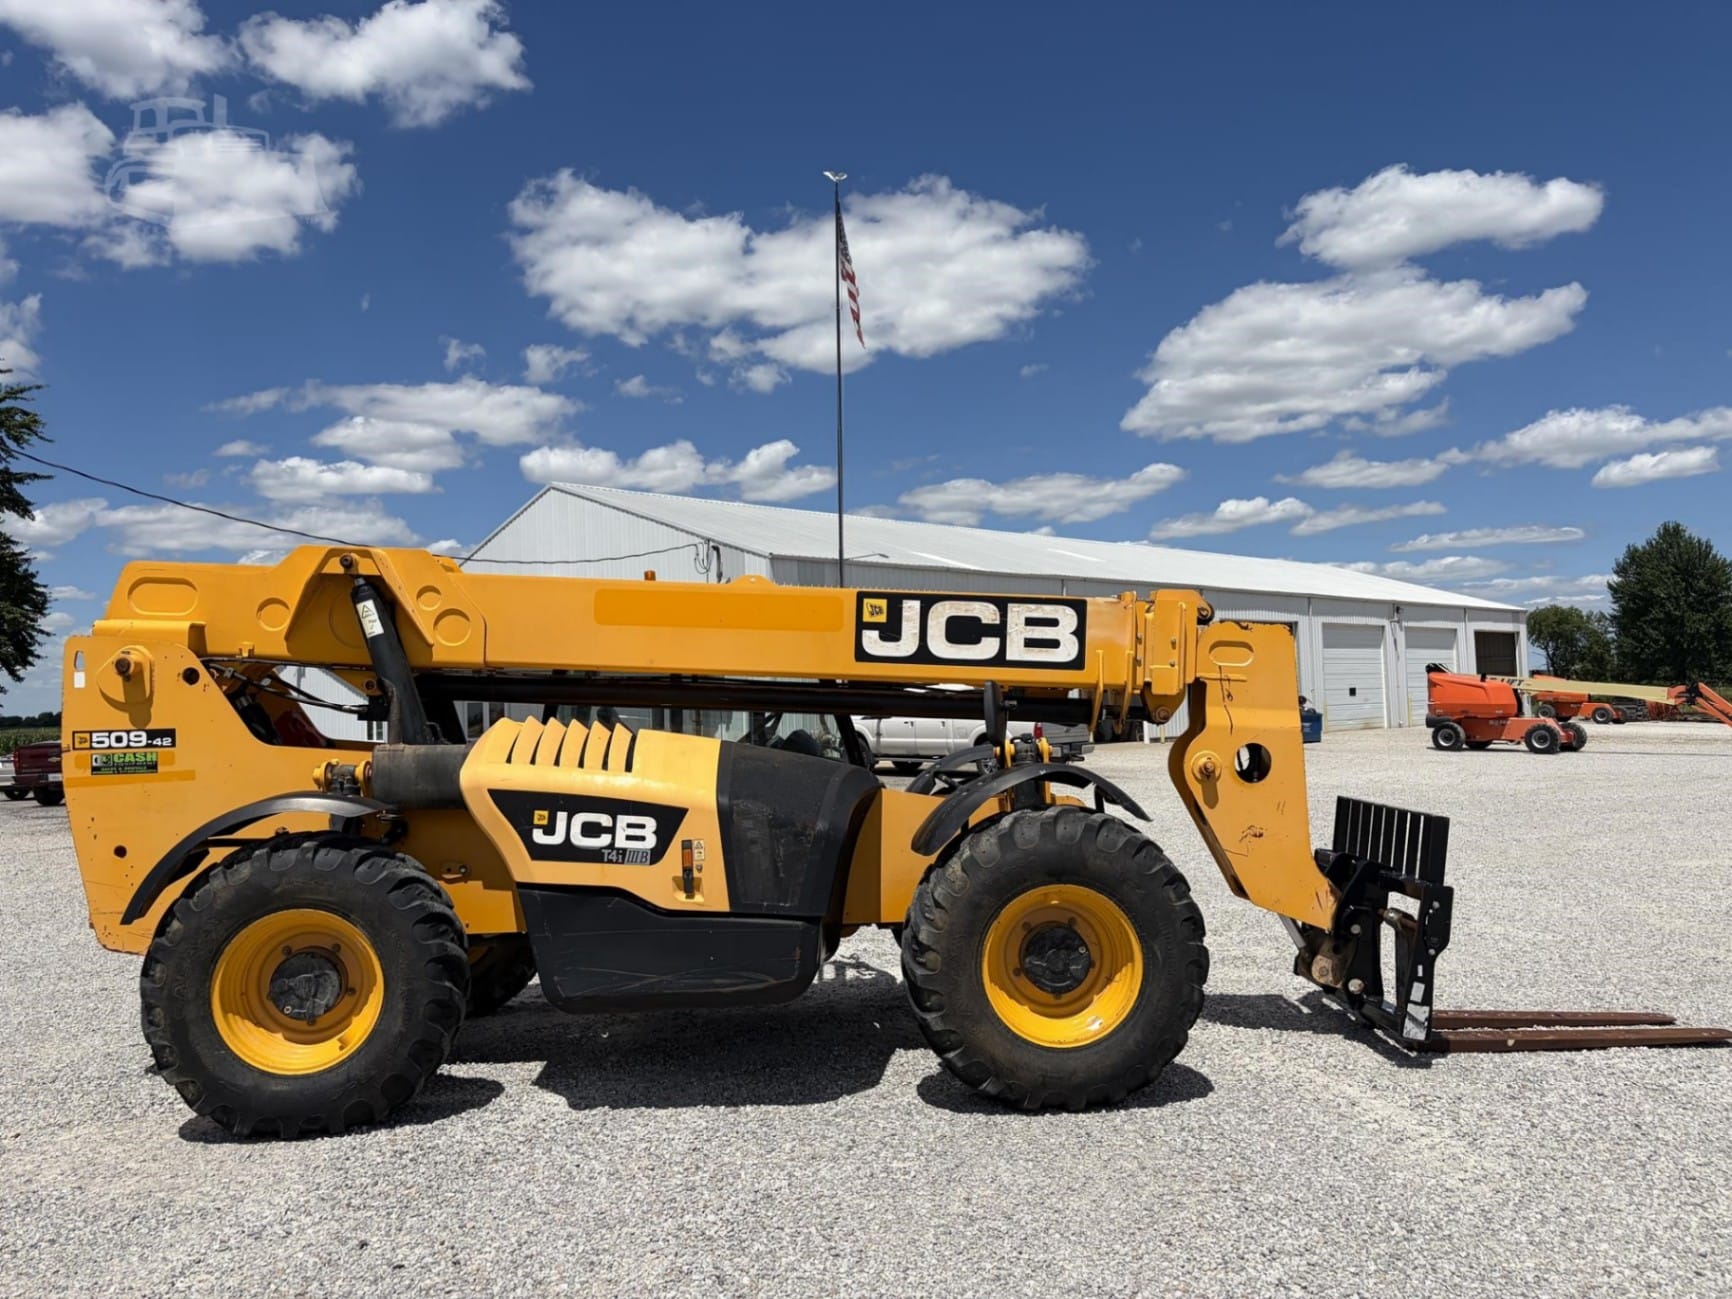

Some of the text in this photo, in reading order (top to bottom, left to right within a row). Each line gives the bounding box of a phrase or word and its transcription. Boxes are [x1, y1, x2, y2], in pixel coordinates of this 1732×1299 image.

[862, 600, 1079, 663] JCB
[92, 731, 172, 748] 509-42
[113, 752, 157, 762] CASH
[532, 811, 657, 849] JCB
